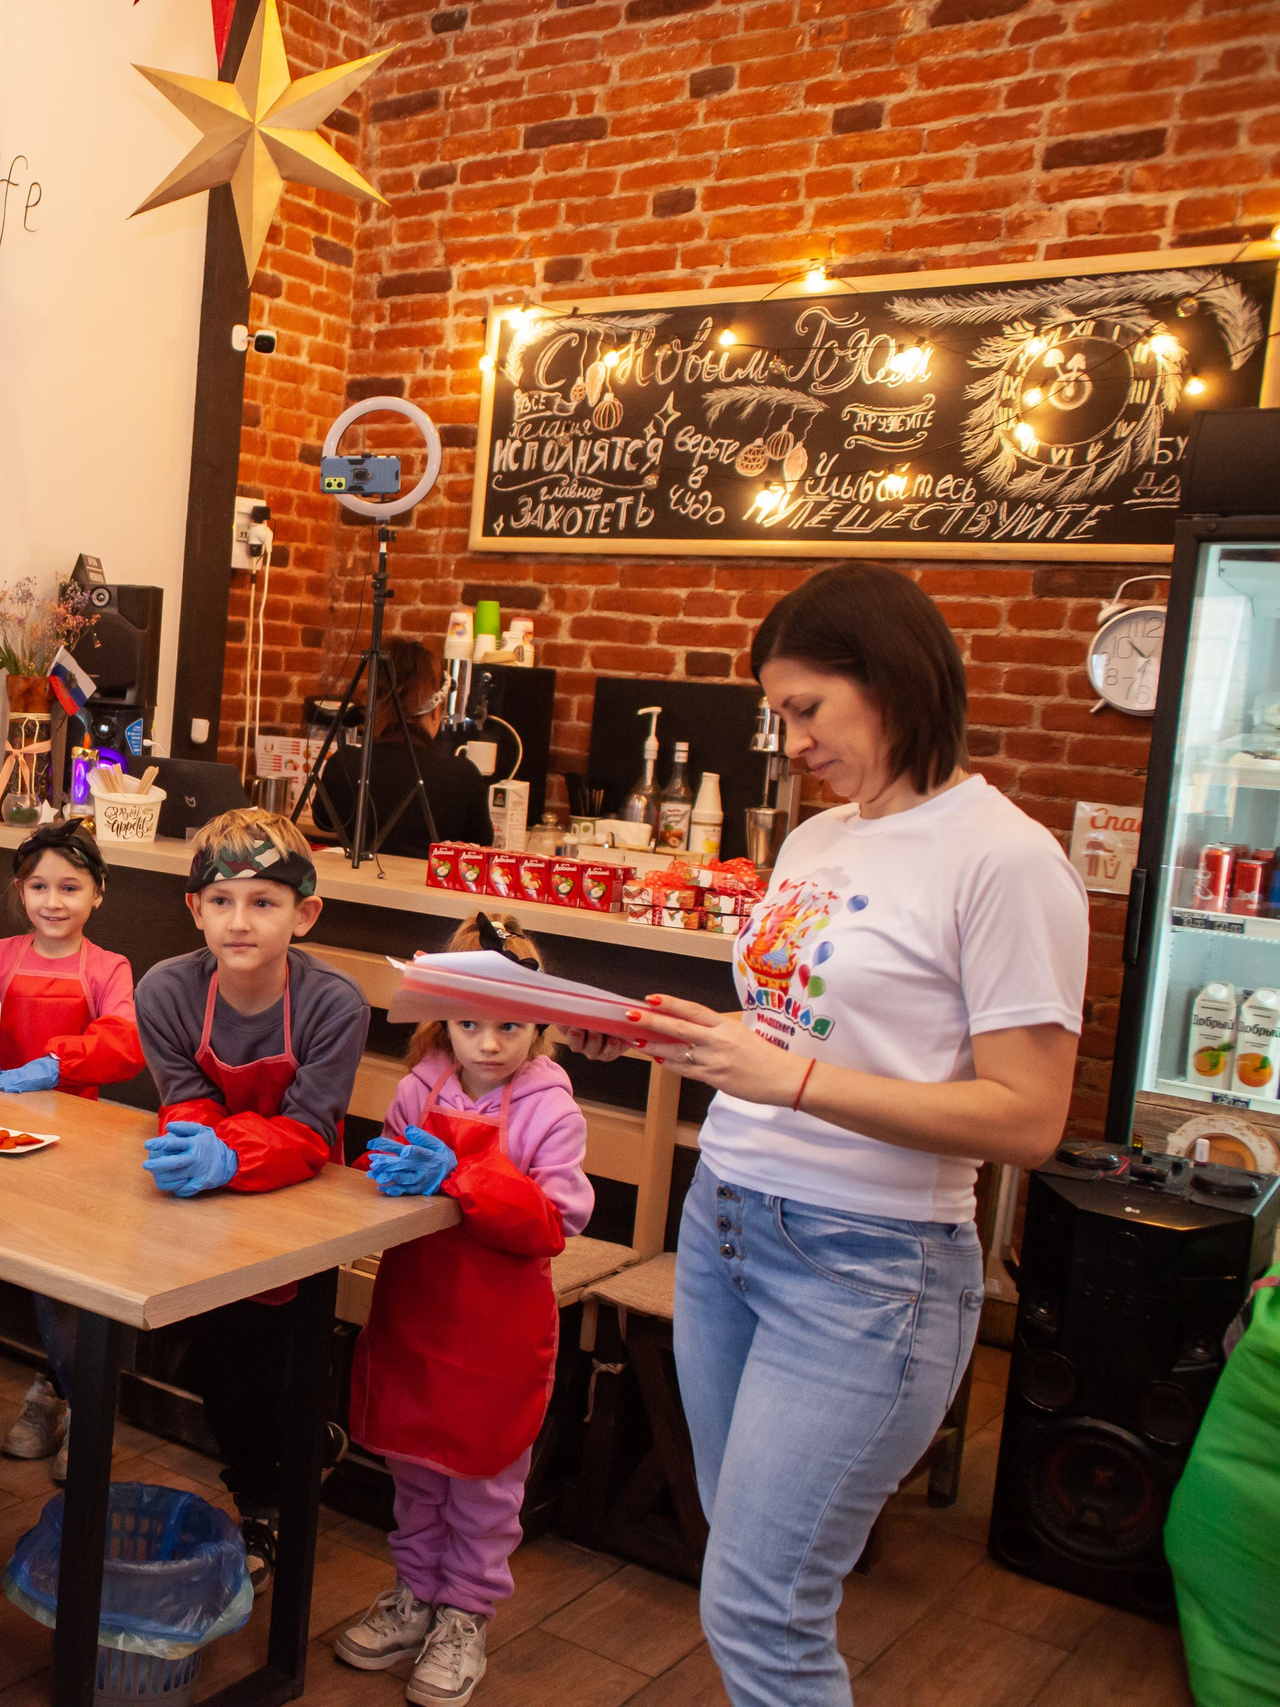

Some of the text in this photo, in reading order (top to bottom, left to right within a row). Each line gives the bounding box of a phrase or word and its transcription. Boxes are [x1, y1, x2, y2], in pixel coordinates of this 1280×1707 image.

[534, 332, 580, 389] С
[520, 393, 548, 414] ВСЕ
[853, 409, 936, 432] ДРУЖИТЕ
[492, 435, 664, 478] ИСПОЛНЯТСЯ
[674, 425, 740, 468] верьте
[540, 477, 604, 501] главное
[510, 492, 655, 535] ЗАХОТЕТЬ
[1192, 1014, 1234, 1030] Добрый
